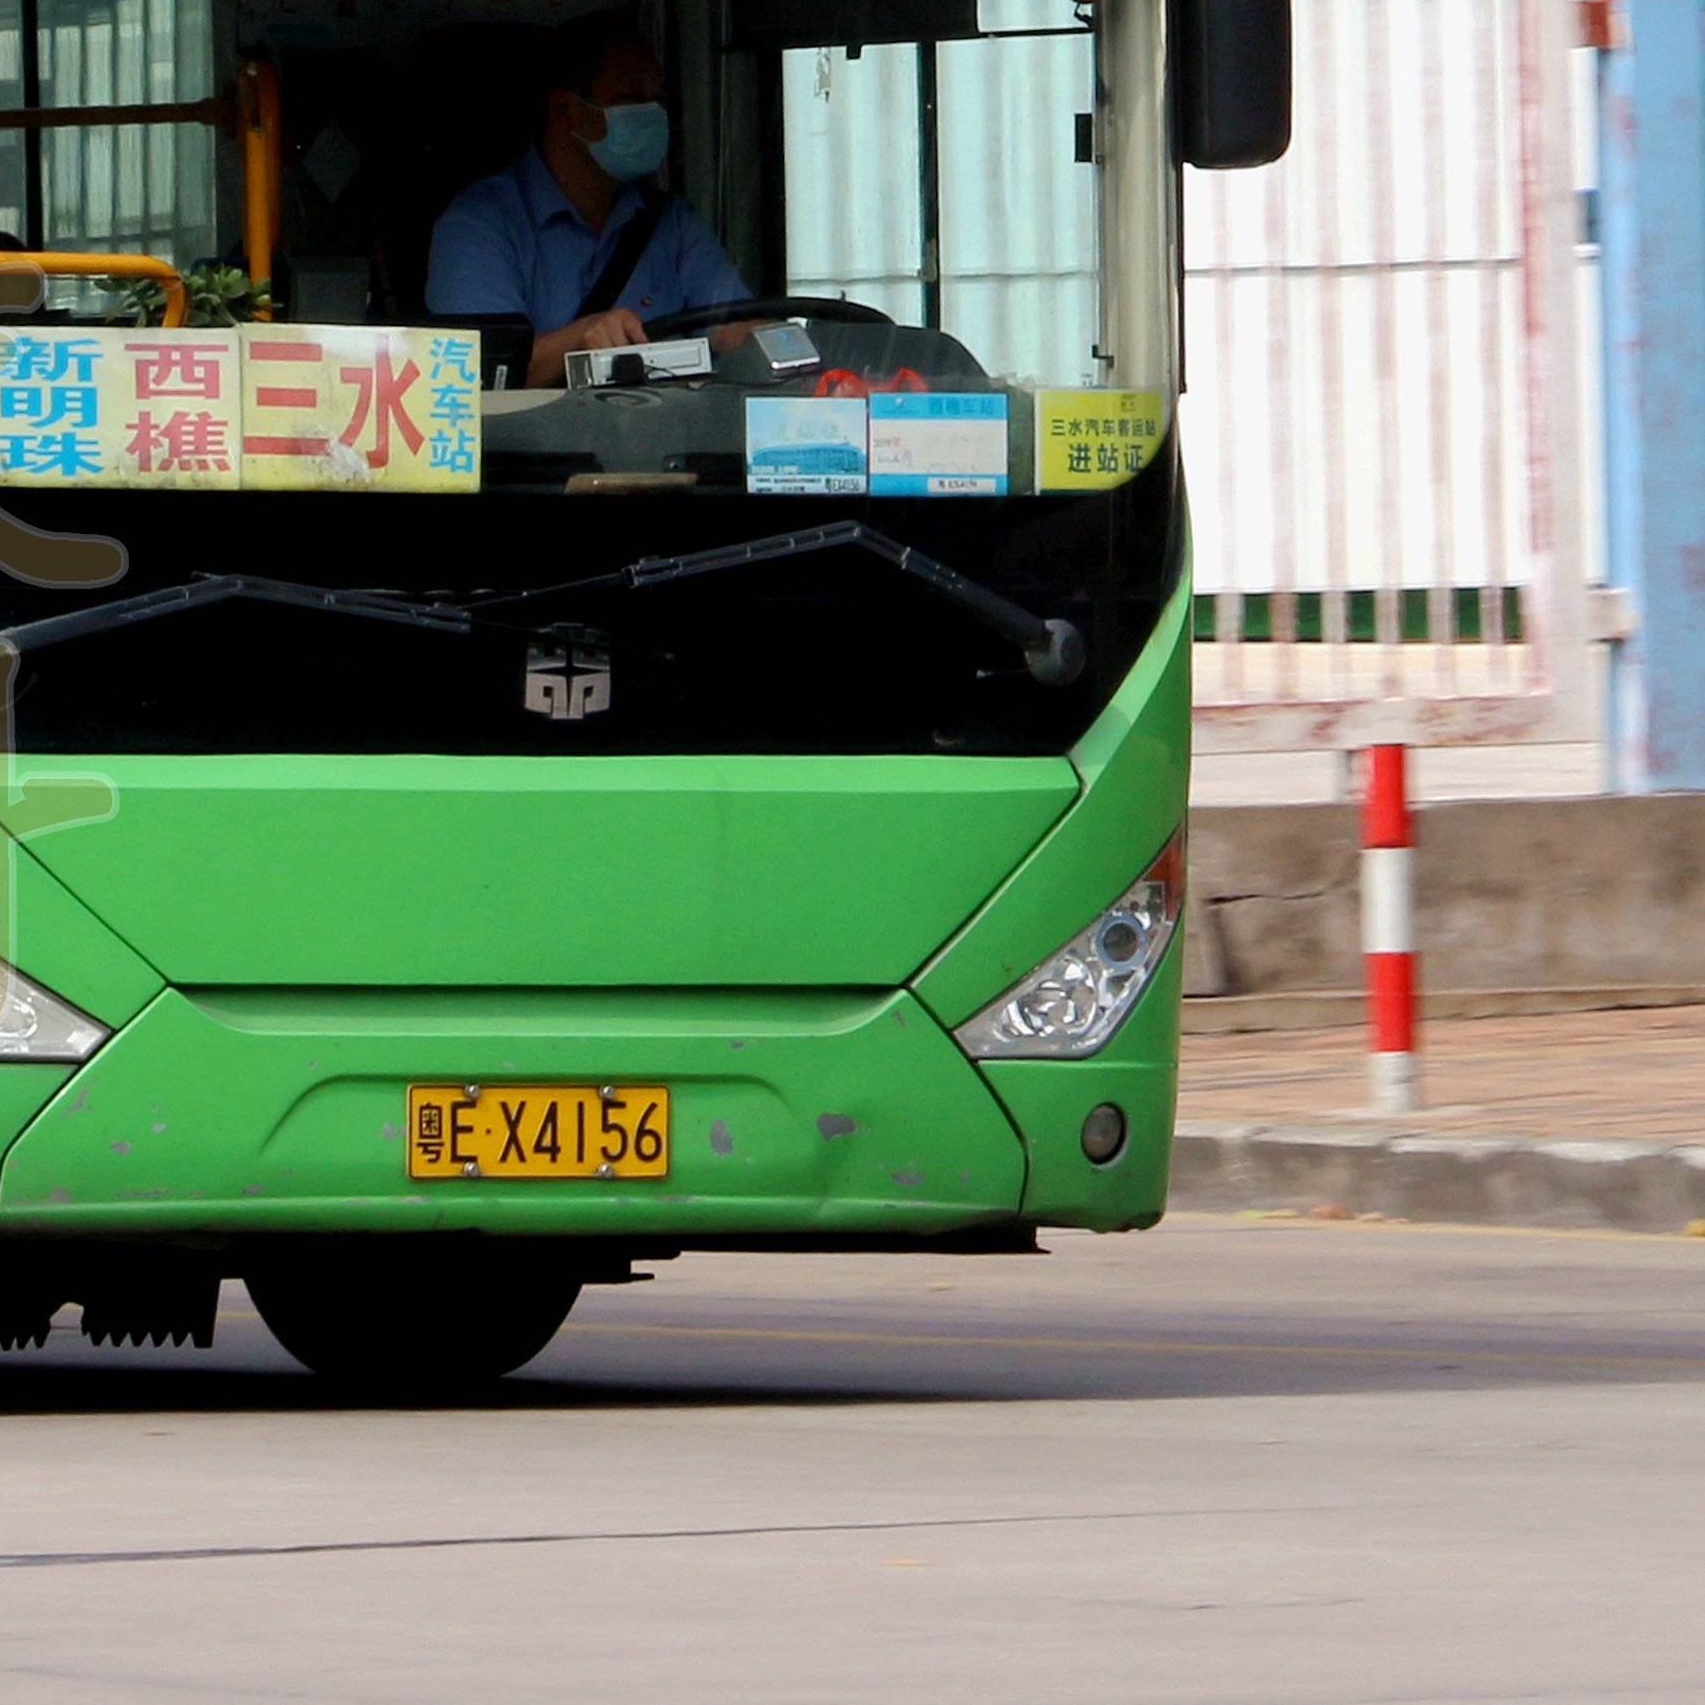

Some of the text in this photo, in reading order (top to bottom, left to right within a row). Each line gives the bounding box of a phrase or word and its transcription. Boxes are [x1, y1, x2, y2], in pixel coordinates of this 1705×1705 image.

[123, 342, 230, 474] 西樵
[242, 334, 425, 470] 三水
[428, 336, 476, 474] 汽车站
[1050, 418, 1156, 437] 三水汽车客运站
[1067, 442, 1144, 473] 进站证
